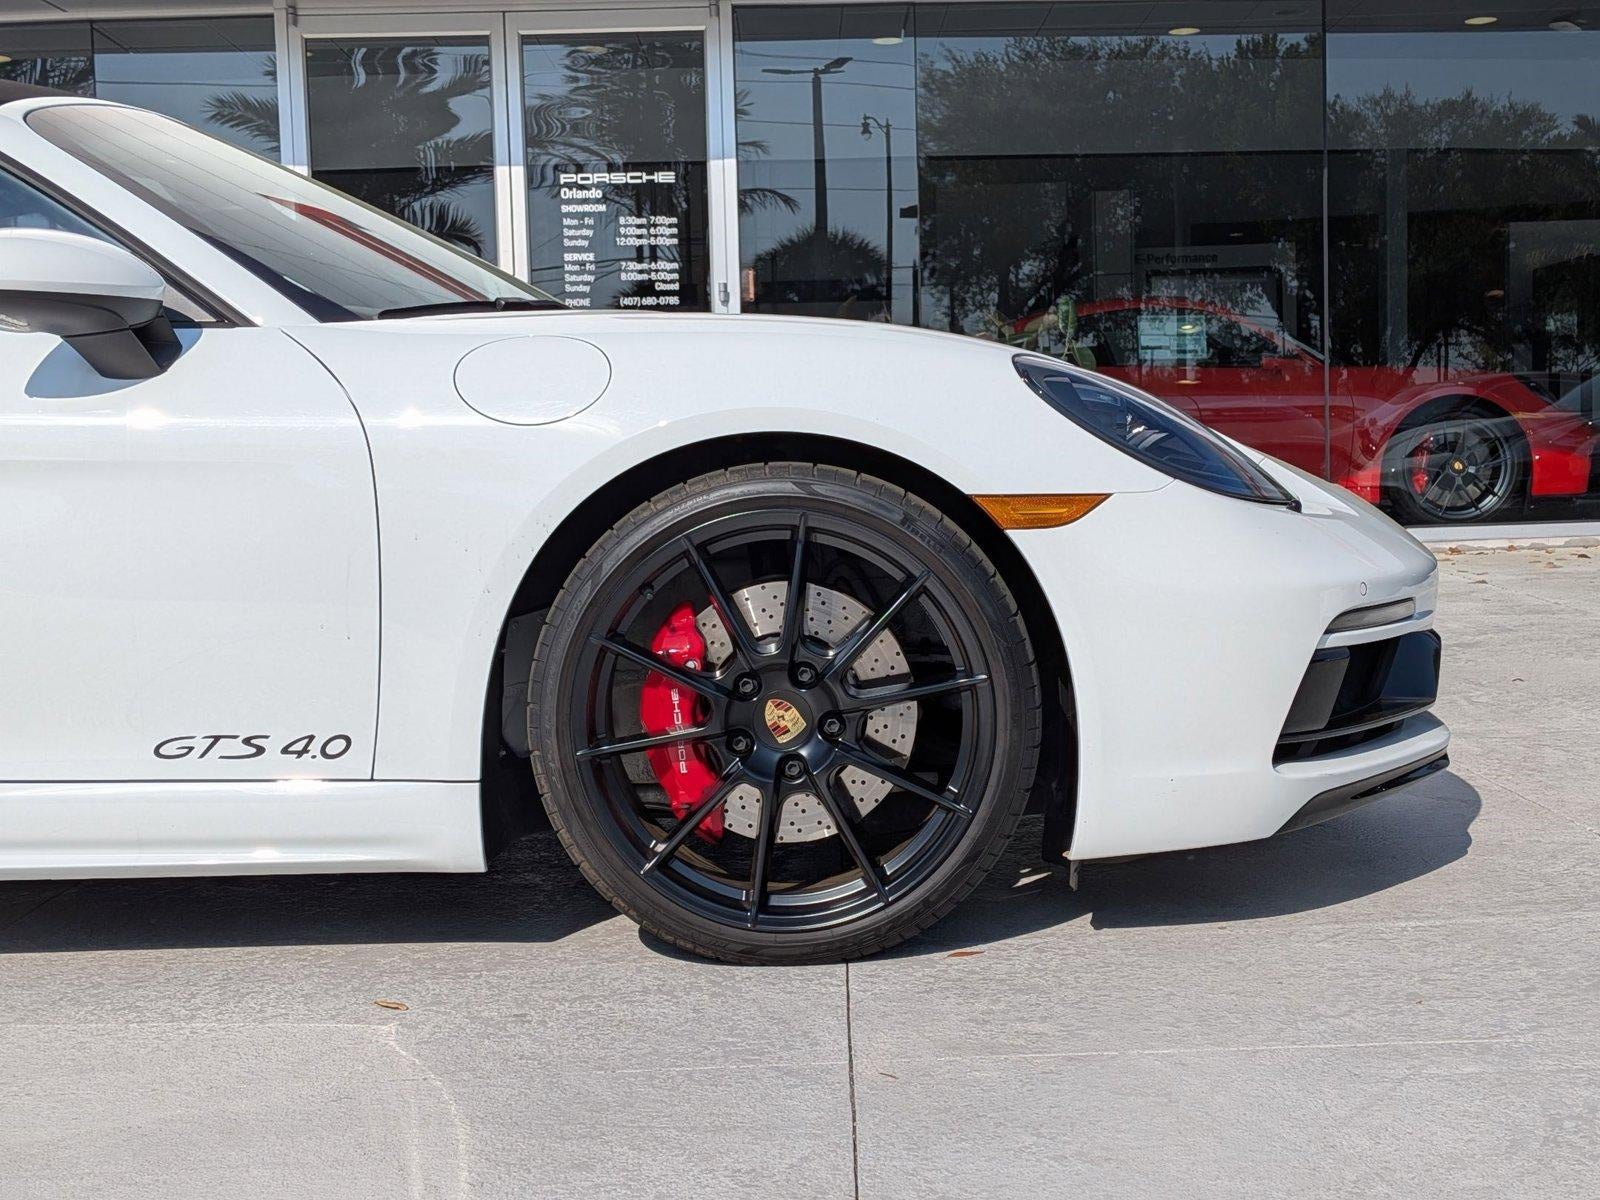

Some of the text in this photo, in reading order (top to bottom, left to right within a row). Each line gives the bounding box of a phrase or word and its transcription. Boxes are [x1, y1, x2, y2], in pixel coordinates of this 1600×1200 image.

[560, 171, 676, 185] PORSCHE
[560, 187, 602, 199] Orlando
[560, 204, 606, 213] SHOWROOM
[562, 218, 579, 226] Mon
[585, 217, 594, 226] Fri
[562, 227, 594, 238] Saturday
[563, 238, 590, 248] Sunday
[563, 252, 595, 262] SERVICE
[1135, 251, 1219, 266] E-Performance
[564, 263, 580, 271] Mon
[585, 262, 596, 271] Fri
[564, 273, 596, 283] Saturday
[564, 281, 680, 294] Sunday Closed
[564, 298, 591, 307] PHONE
[619, 296, 641, 307] (407)
[153, 733, 353, 760] GTS 4.0
